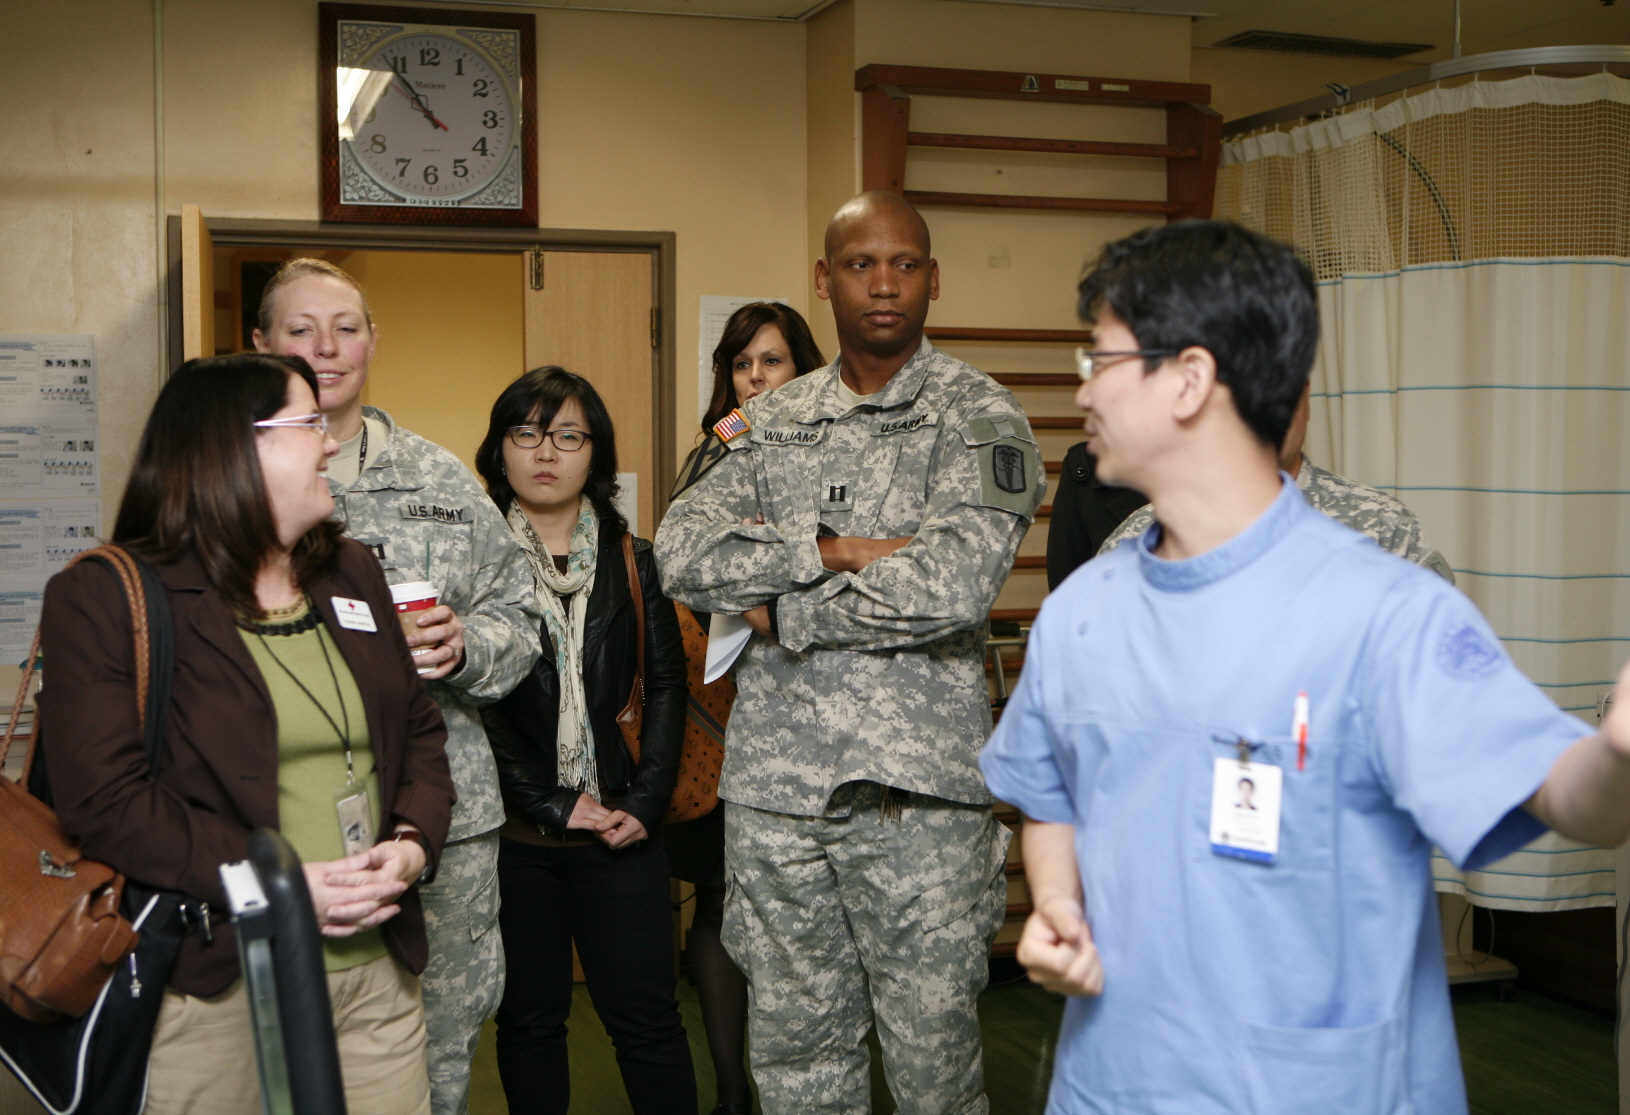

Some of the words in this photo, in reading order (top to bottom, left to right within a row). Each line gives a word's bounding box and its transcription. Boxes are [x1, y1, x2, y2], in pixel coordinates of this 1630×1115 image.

[391, 55, 408, 74] 11
[419, 48, 441, 66] 12
[455, 58, 465, 76] 1
[473, 79, 489, 98] 2
[482, 110, 498, 129] 3
[370, 134, 387, 154] 8
[472, 137, 489, 156] 4
[395, 158, 411, 177] 7
[423, 165, 439, 185] 6
[453, 158, 469, 178] 5
[898, 413, 929, 430] ARMY
[764, 430, 819, 442] WILLIAMS
[432, 505, 463, 521] ARMY
